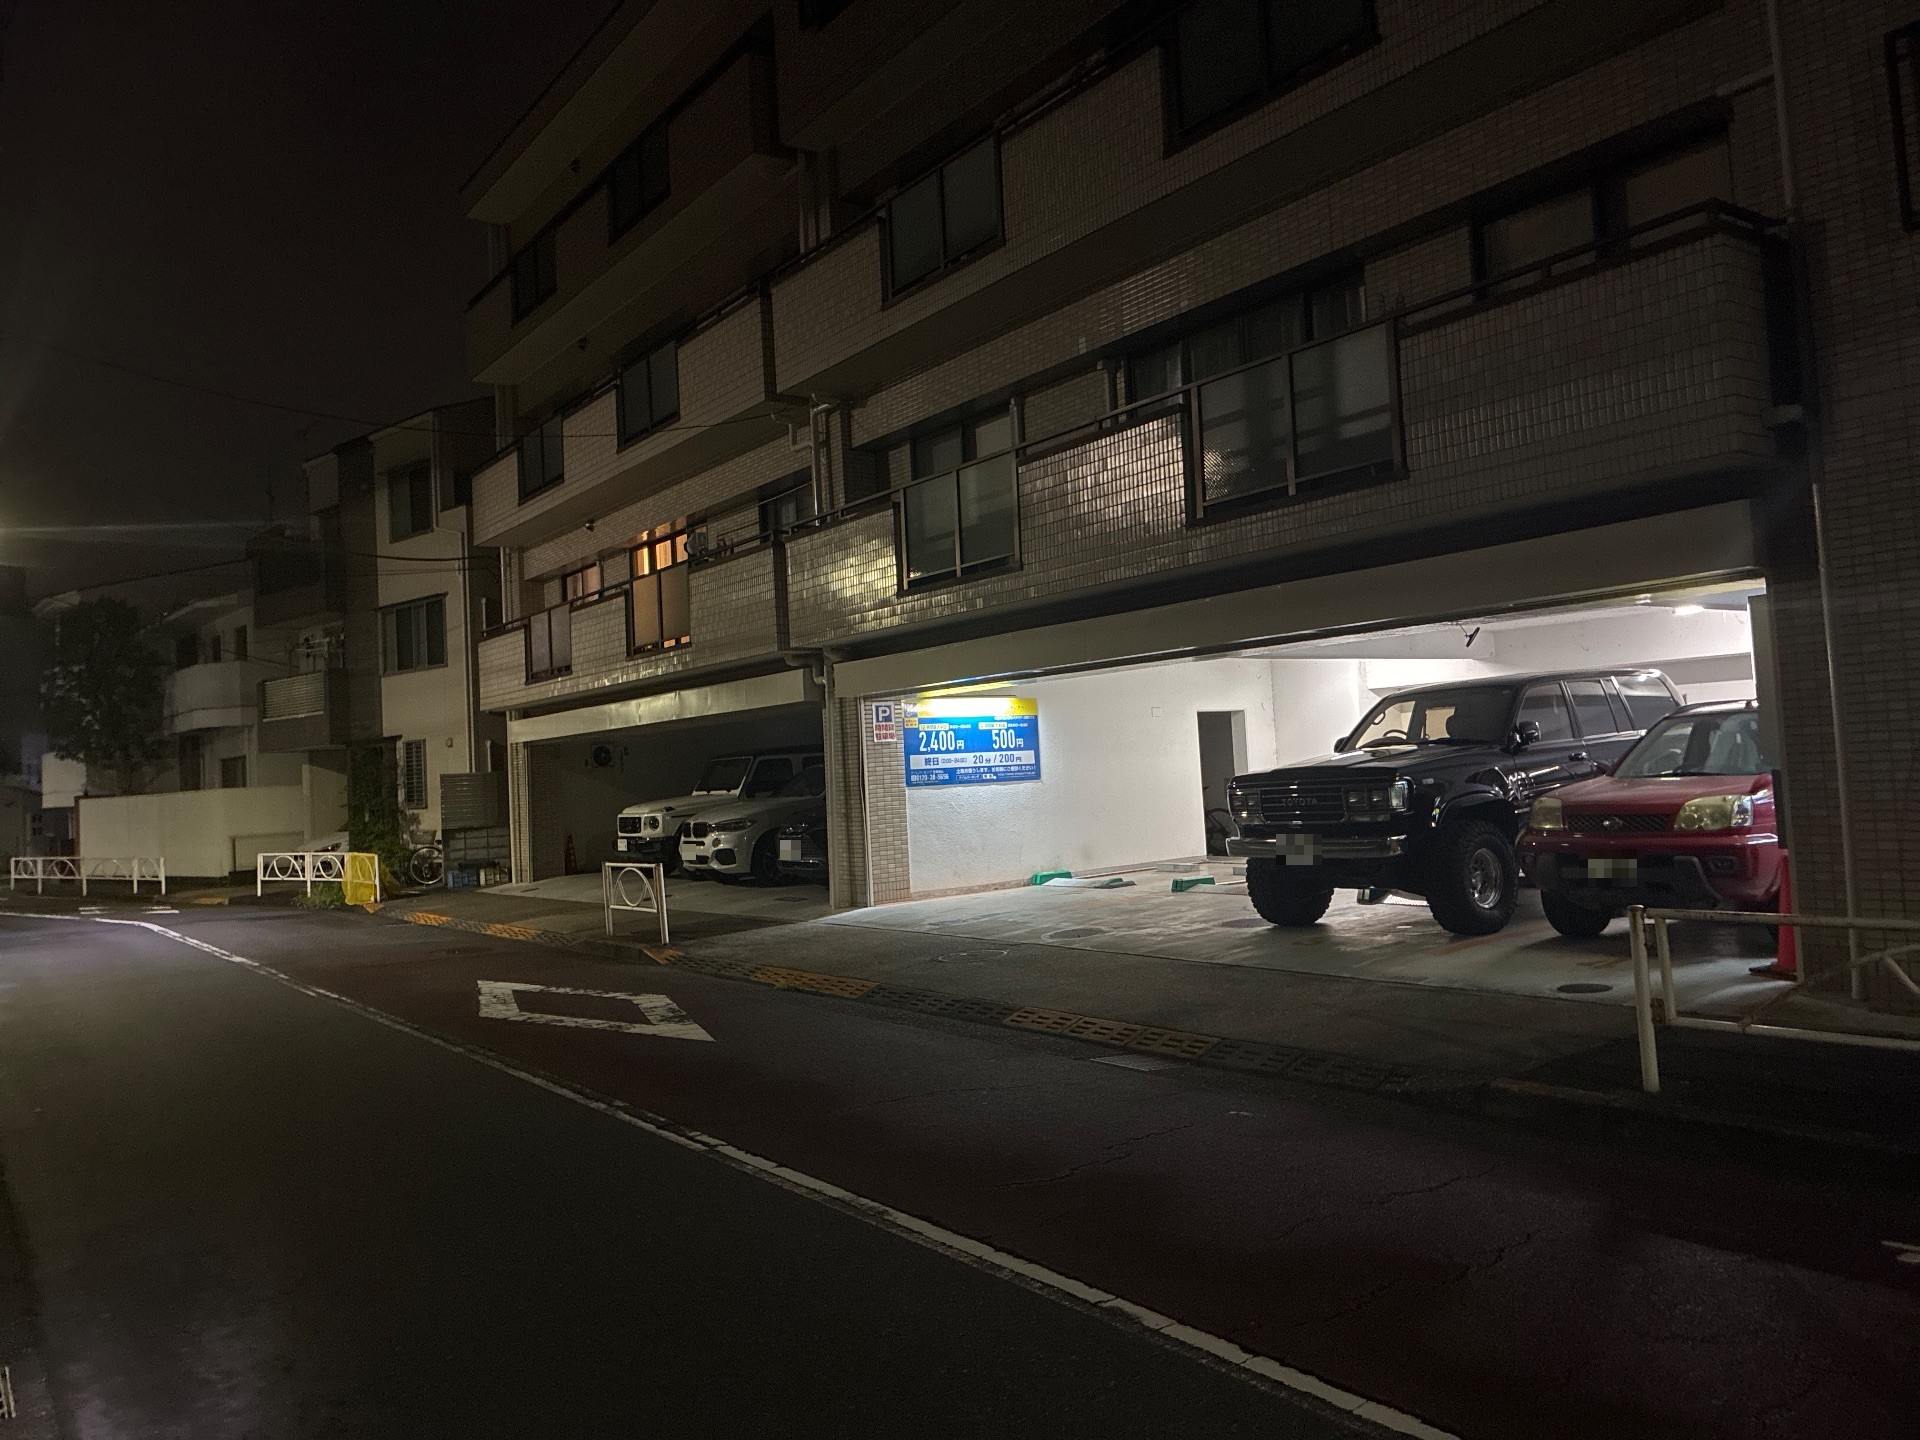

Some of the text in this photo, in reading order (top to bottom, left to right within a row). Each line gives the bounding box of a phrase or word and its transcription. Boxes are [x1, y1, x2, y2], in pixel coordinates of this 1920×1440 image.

[878, 706, 890, 721] P
[876, 732, 896, 741] 駐車場
[924, 757, 939, 766] 終日
[1282, 797, 1317, 806] TOYOTA
